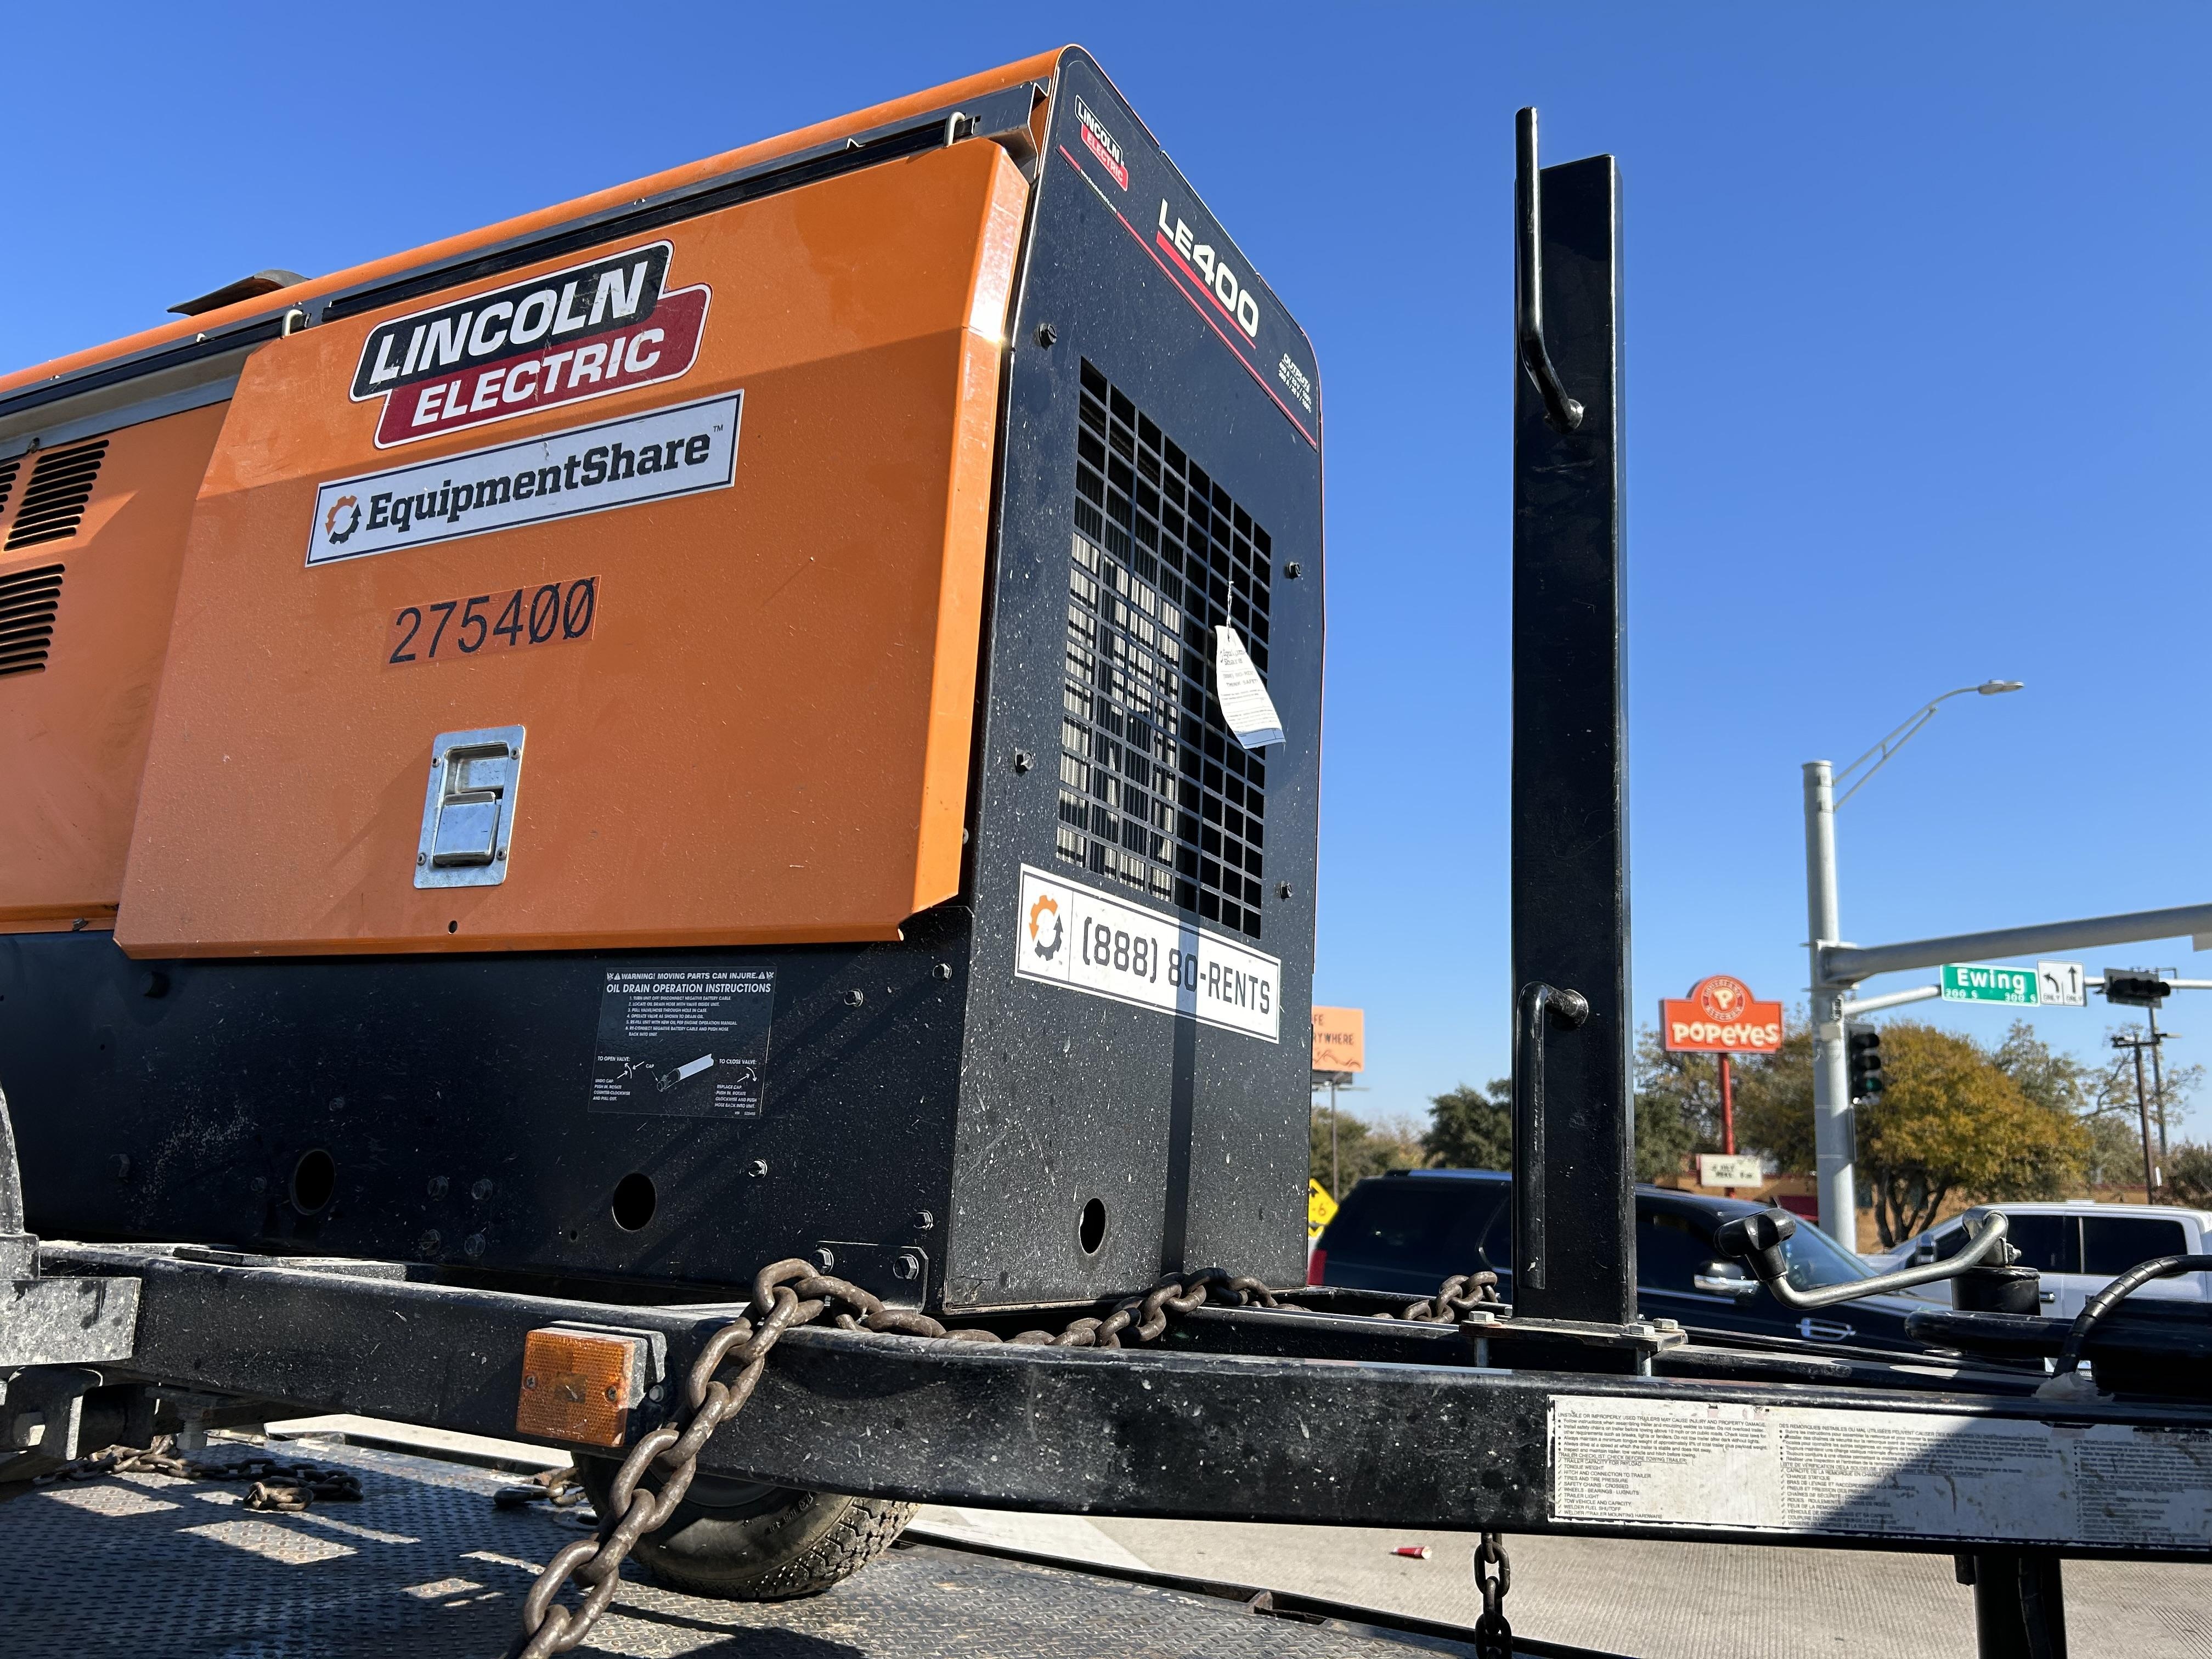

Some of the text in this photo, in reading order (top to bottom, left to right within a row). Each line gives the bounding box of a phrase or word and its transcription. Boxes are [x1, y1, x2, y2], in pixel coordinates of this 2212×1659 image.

[1078, 101, 1119, 163] LINCOLN
[1087, 131, 1124, 182] ELECTRIC
[1159, 199, 1259, 337] LE400
[369, 261, 649, 385] LINCOLN
[411, 328, 665, 428] ELECTRIC
[1284, 353, 1308, 387] OUTPUT
[366, 433, 710, 532] EquipmentShare
[389, 577, 596, 664] 275400
[606, 983, 771, 993] OIL DRAIN OPERATION INSTRUCTIONS
[1083, 916, 1270, 1014] (888) 80-RENTS
[1957, 968, 2025, 995] Ewing
[1971, 990, 1978, 998] S
[2030, 994, 2036, 1002] S
[1712, 986, 1734, 1011] P
